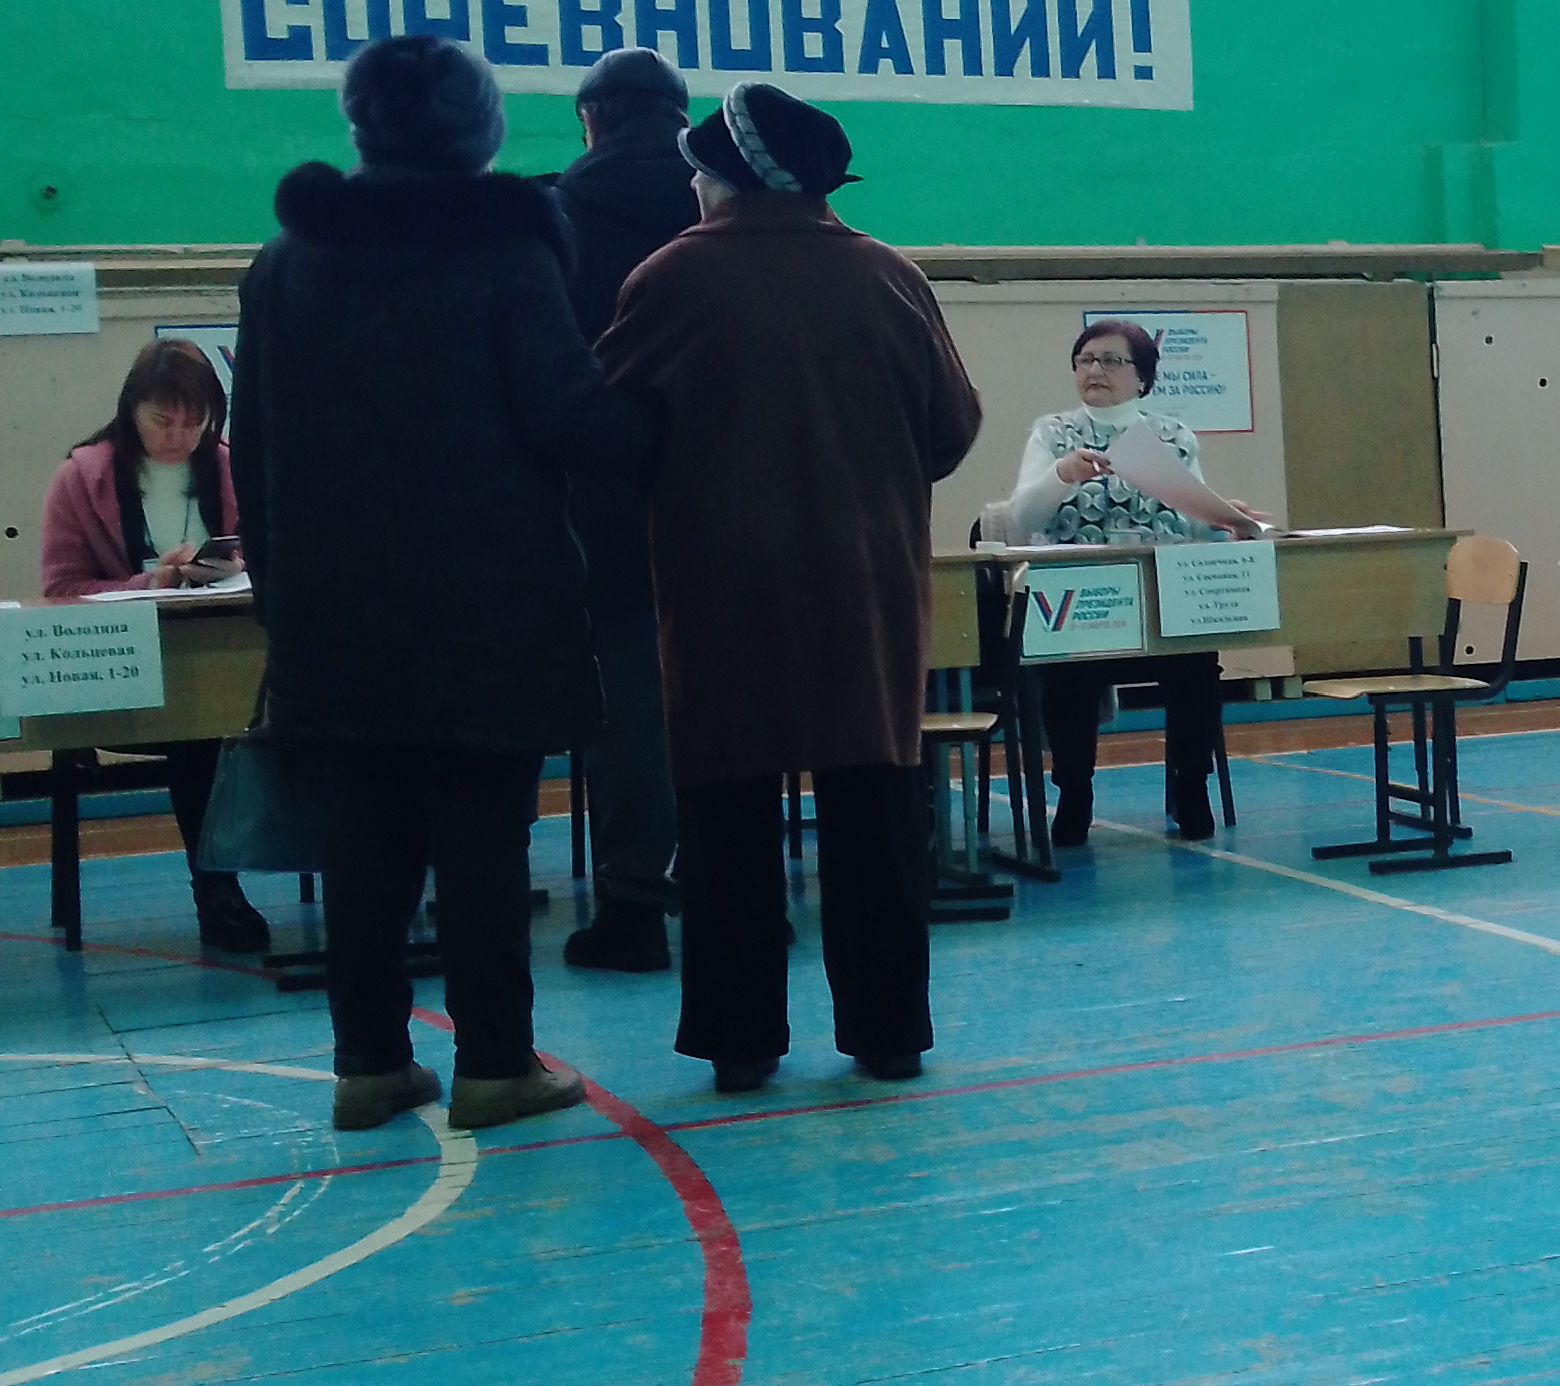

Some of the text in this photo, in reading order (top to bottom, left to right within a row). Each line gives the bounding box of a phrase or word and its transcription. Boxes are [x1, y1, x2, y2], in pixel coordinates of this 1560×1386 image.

[25, 623, 129, 642] ул. Володина
[22, 645, 136, 664] ул. Кольцевая
[22, 675, 45, 688] ул.
[108, 666, 141, 680] 1-20
